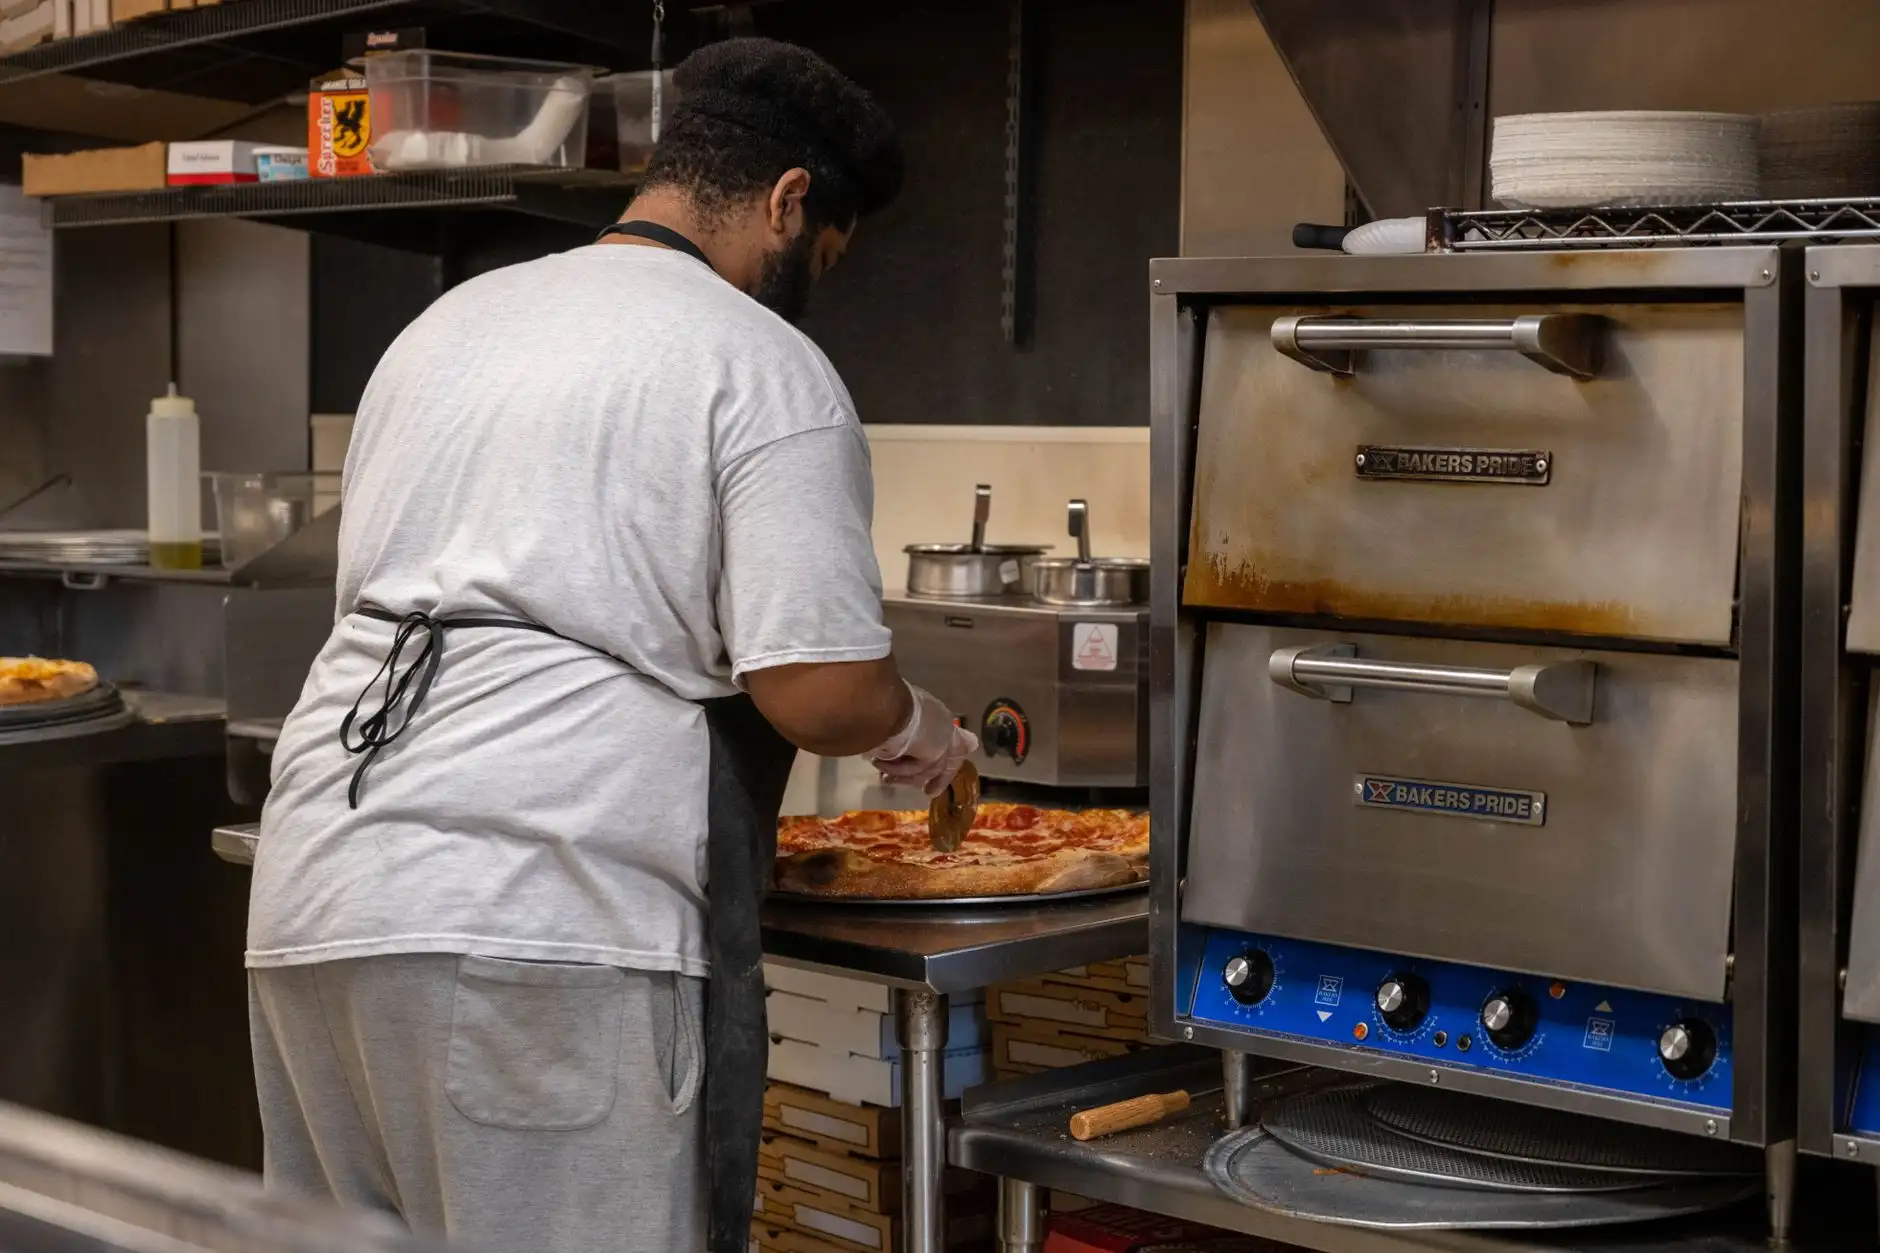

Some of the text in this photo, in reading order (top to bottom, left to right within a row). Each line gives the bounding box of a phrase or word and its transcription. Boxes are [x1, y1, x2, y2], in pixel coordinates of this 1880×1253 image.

[317, 96, 335, 176] Sprecher
[1397, 453, 1534, 475] BAKERS PRIDE
[1396, 786, 1530, 817] BAKERS PRIDE
